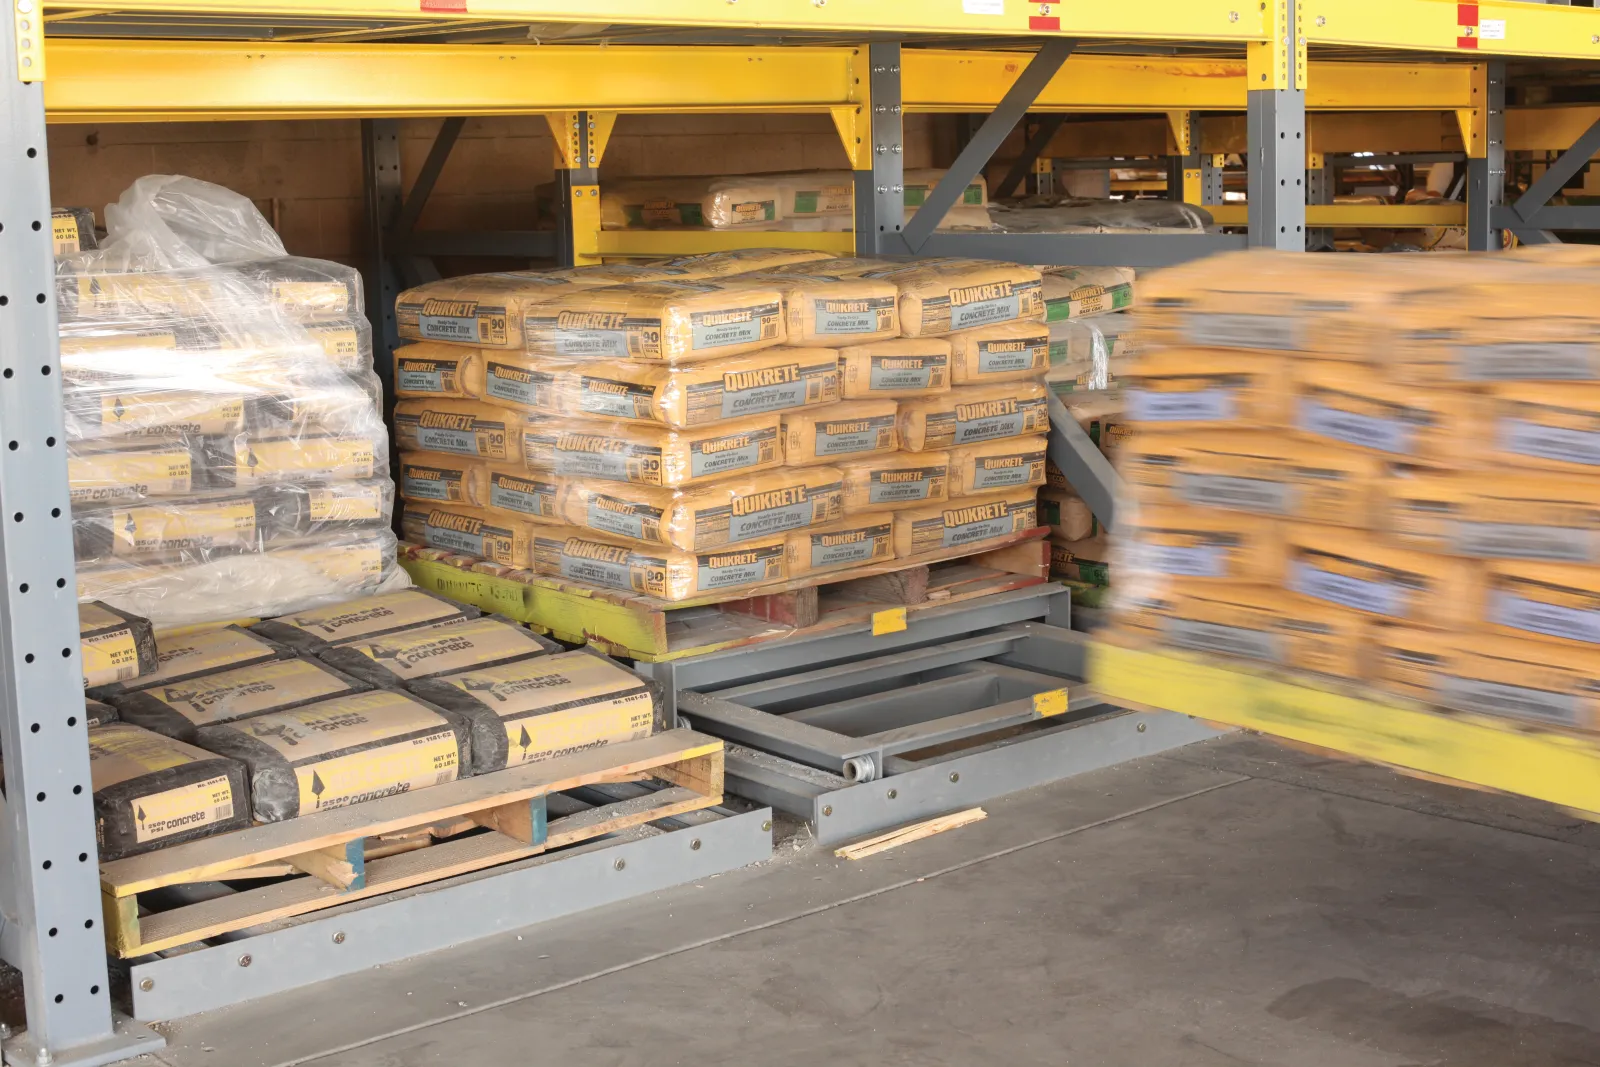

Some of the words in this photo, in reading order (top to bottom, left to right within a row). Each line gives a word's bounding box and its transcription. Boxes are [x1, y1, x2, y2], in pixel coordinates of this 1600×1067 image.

[950, 280, 1013, 307] QUIKRETE
[1032, 291, 1043, 302] 90
[1070, 286, 1106, 301] QUIKRETE
[421, 298, 478, 318] QUIKRETE
[826, 302, 870, 314] QUIKRETE
[960, 308, 997, 322] CONCRETE
[997, 306, 1011, 315] MIX
[491, 318, 505, 329] 90
[558, 311, 626, 331] QUIKRETE
[703, 311, 753, 327] QUIKRETE
[762, 317, 771, 325] 90
[427, 324, 456, 334] CONCRETE
[457, 326, 470, 334] MIX
[705, 330, 738, 341] CONCRETE
[643, 331, 659, 344] 90
[988, 342, 1026, 353] QUIKRETE
[403, 361, 436, 373] QUIKRETE
[881, 359, 924, 370] QUIKRETE
[494, 366, 532, 384] QUIKRETE
[724, 364, 801, 393] QUIKRETE
[824, 374, 837, 388] 90
[589, 382, 629, 397] QUIKRETE
[733, 394, 778, 409] CONCRETE
[778, 391, 796, 401] MIX
[956, 398, 1018, 422] QUIKRETE
[1038, 408, 1048, 419] 90
[420, 410, 476, 432] QUIKRETE
[147, 423, 201, 436] concrete
[826, 422, 871, 436] QUIKRETE
[963, 425, 998, 437] CONCRETE
[425, 436, 455, 446] CONCRETE
[489, 434, 504, 445] 90
[557, 434, 626, 453] QUIKRETE
[702, 437, 751, 455] QUIKRETE
[827, 441, 856, 449] CONCRETE
[643, 460, 659, 470] 90
[704, 457, 736, 468] CONCRETE
[737, 455, 749, 464] MIX
[985, 457, 1024, 470] QUIKRETE
[409, 468, 441, 481] QUIKRETE
[881, 472, 924, 484] QUIKRETE
[499, 477, 536, 495] QUIKRETE
[596, 497, 637, 515] QUIKRETE
[732, 486, 808, 517] QUIKRETE
[830, 494, 842, 508] 90
[642, 518, 651, 526] 90
[944, 502, 1008, 528] QUIKRETE
[1028, 511, 1036, 521] 90
[427, 510, 485, 535] QUIKRETE
[740, 516, 783, 532] CONCRETE
[785, 513, 802, 523] MIX
[822, 532, 867, 547] QUIKRETE
[952, 529, 989, 542] CONCRETE
[989, 526, 1004, 535] MIX
[432, 535, 463, 548] CONCRETE
[497, 540, 511, 552] 90
[563, 539, 632, 565] QUIKRETE
[823, 551, 852, 560] CONCRETE
[709, 553, 759, 569] QUIKRETE
[766, 558, 776, 566] 90
[569, 565, 605, 579] CONCRETE
[607, 572, 621, 582] MIX
[647, 570, 665, 583] 90
[710, 573, 743, 583] CONCRETE
[744, 571, 756, 579] MIX
[331, 610, 395, 628] concrete
[103, 630, 129, 642] 1141-62
[407, 640, 475, 664] concrete
[502, 678, 572, 695] concrete
[426, 732, 452, 743] 1141-62
[553, 739, 609, 759] concrete
[350, 782, 411, 806] concrete
[148, 820, 166, 829] 2500
[167, 811, 206, 829] concrete
